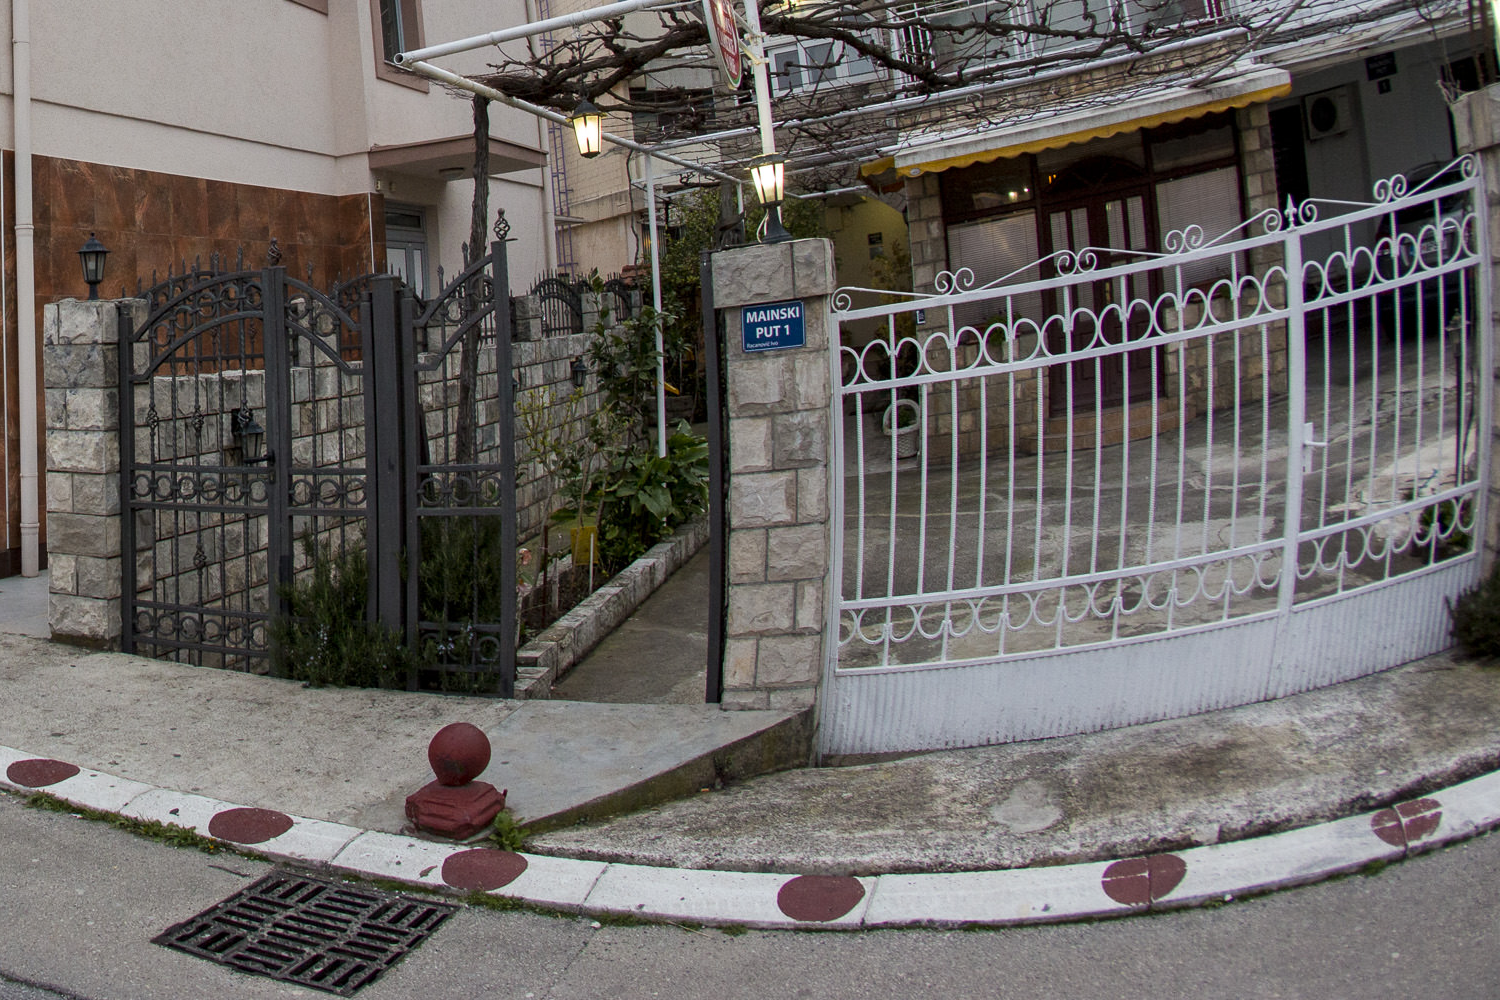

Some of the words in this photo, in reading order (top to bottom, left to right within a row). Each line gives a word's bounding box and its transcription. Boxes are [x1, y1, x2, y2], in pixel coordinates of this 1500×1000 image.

[746, 306, 800, 323] MAINSKI
[755, 325, 781, 339] PUT
[784, 324, 790, 336] 1
